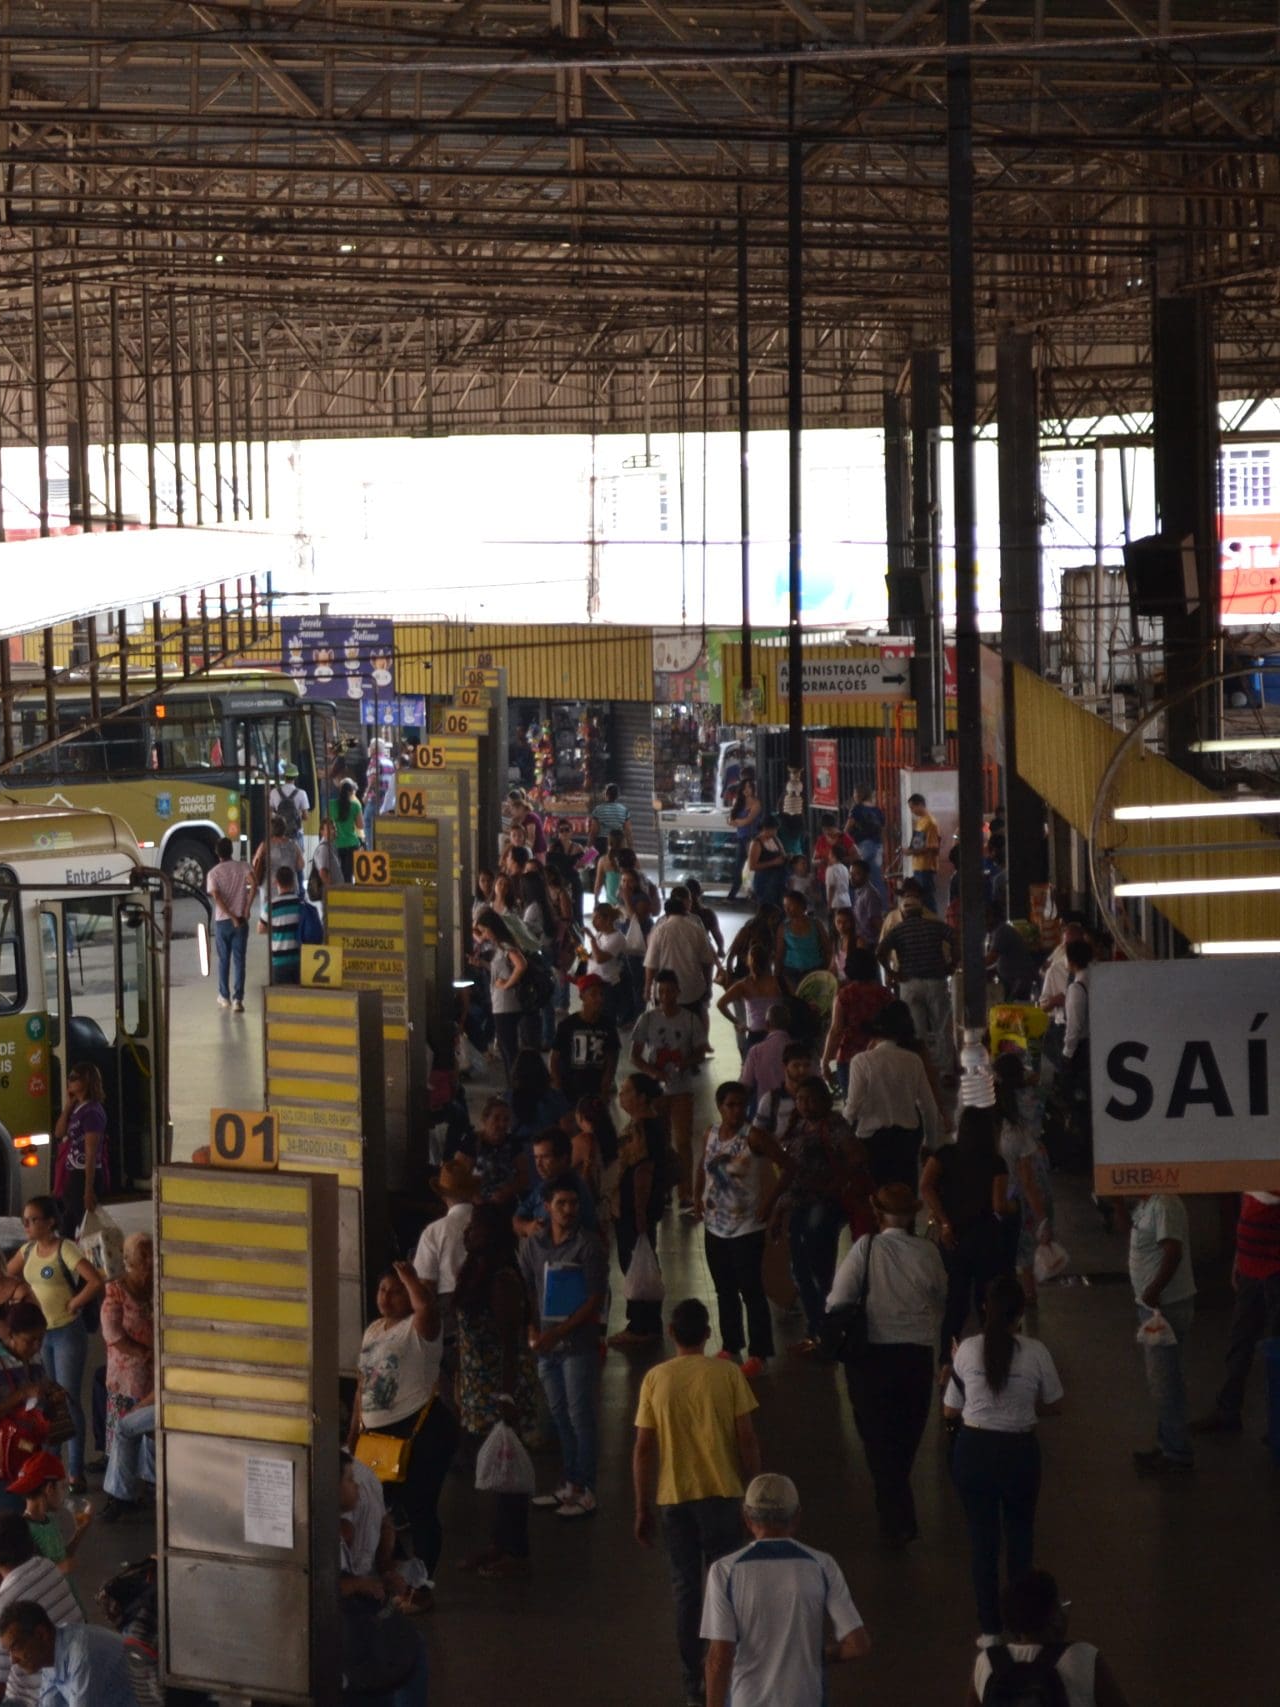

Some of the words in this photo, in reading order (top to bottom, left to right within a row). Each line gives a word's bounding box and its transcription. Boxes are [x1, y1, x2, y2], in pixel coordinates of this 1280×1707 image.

[469, 671, 484, 685] 08
[780, 663, 880, 678] AMINISTRAÇÃO
[781, 679, 867, 694] INORMAÇÕES
[462, 690, 479, 704] 07
[448, 716, 468, 733] 06
[419, 745, 444, 767] 05
[399, 791, 425, 815] 04
[65, 867, 112, 884] Entrada
[356, 855, 388, 882] 03
[312, 949, 331, 984] 2
[0, 1041, 16, 1056] DE
[1104, 1012, 1269, 1122] SAÍ
[215, 1112, 275, 1162] 01
[1111, 1167, 1180, 1185] URBAN
